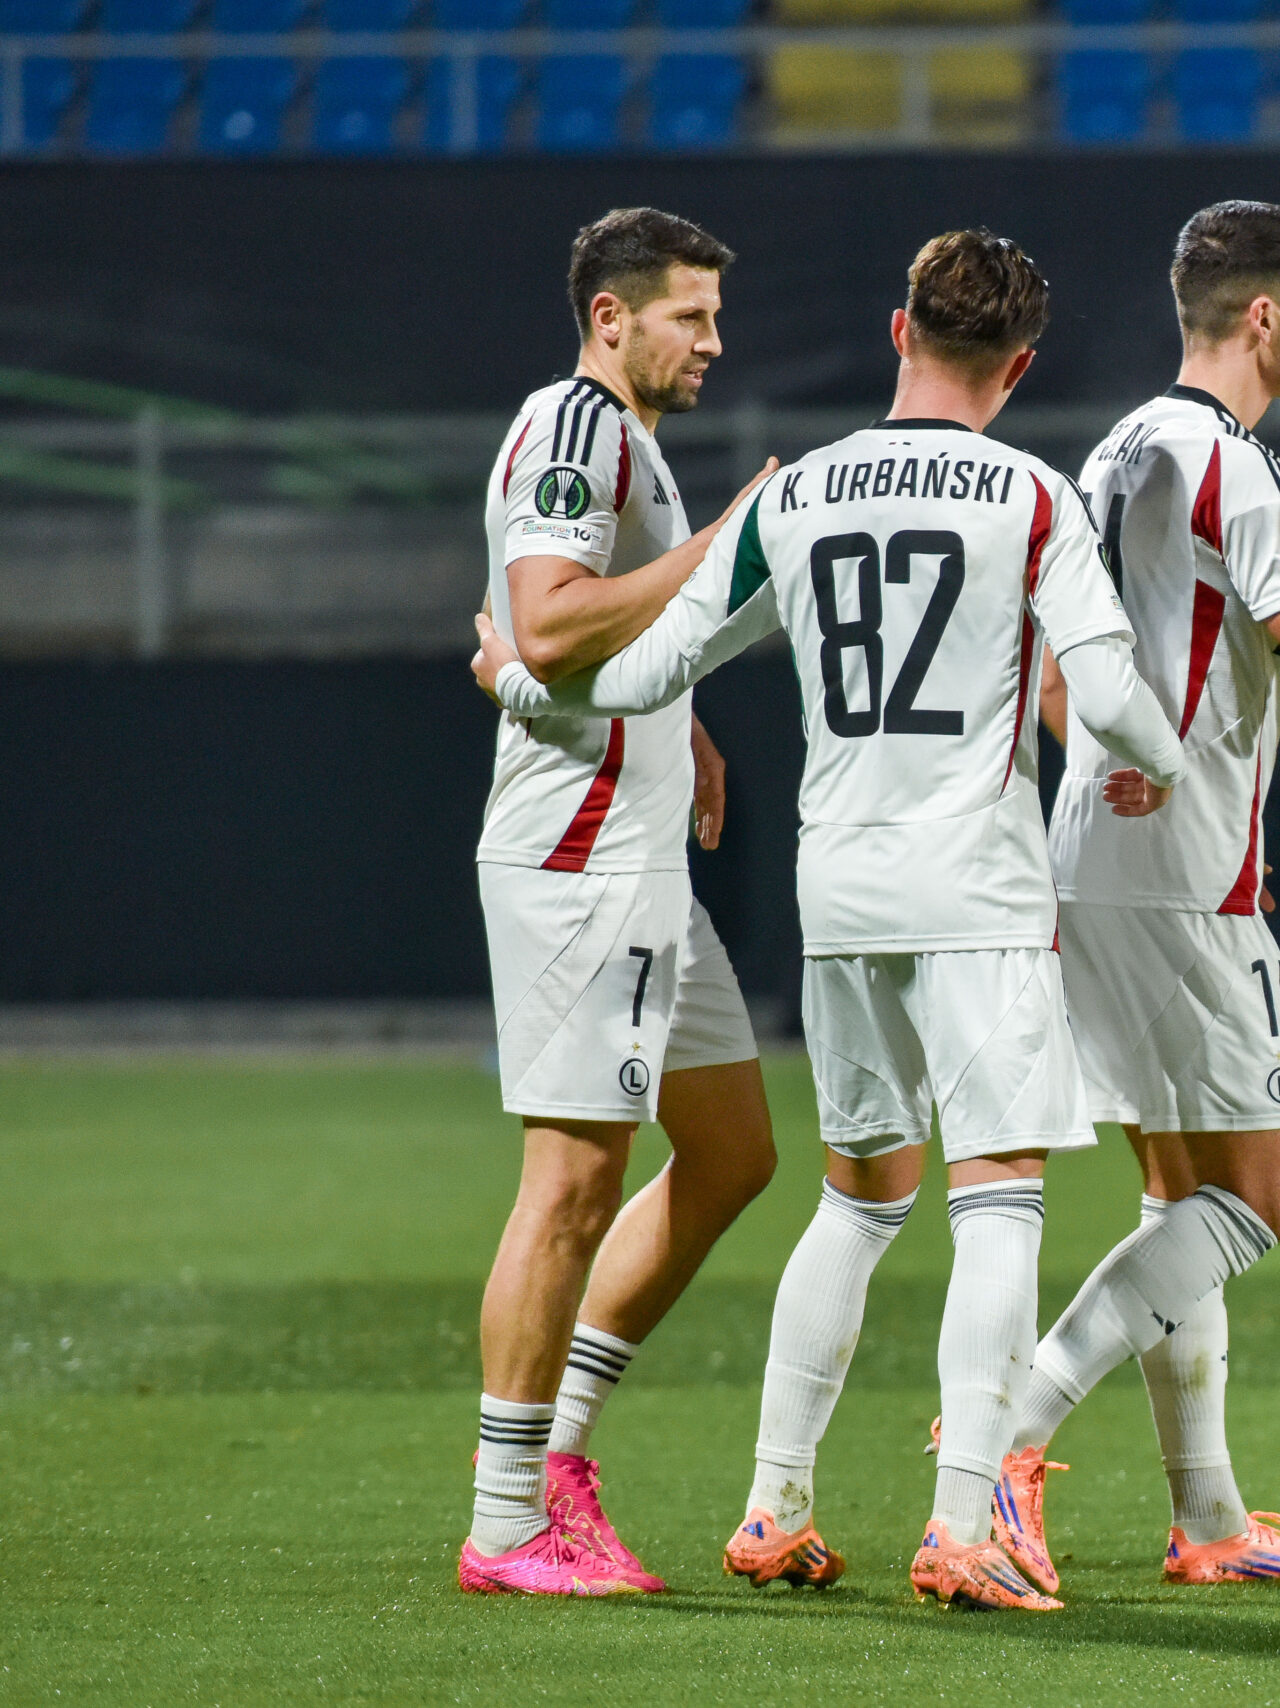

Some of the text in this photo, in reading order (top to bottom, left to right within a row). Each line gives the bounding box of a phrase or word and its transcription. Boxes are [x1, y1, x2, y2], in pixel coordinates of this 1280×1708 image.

[780, 451, 1014, 513] K. URBAŃSKI
[810, 529, 965, 738] 82
[629, 946, 653, 1027] 7
